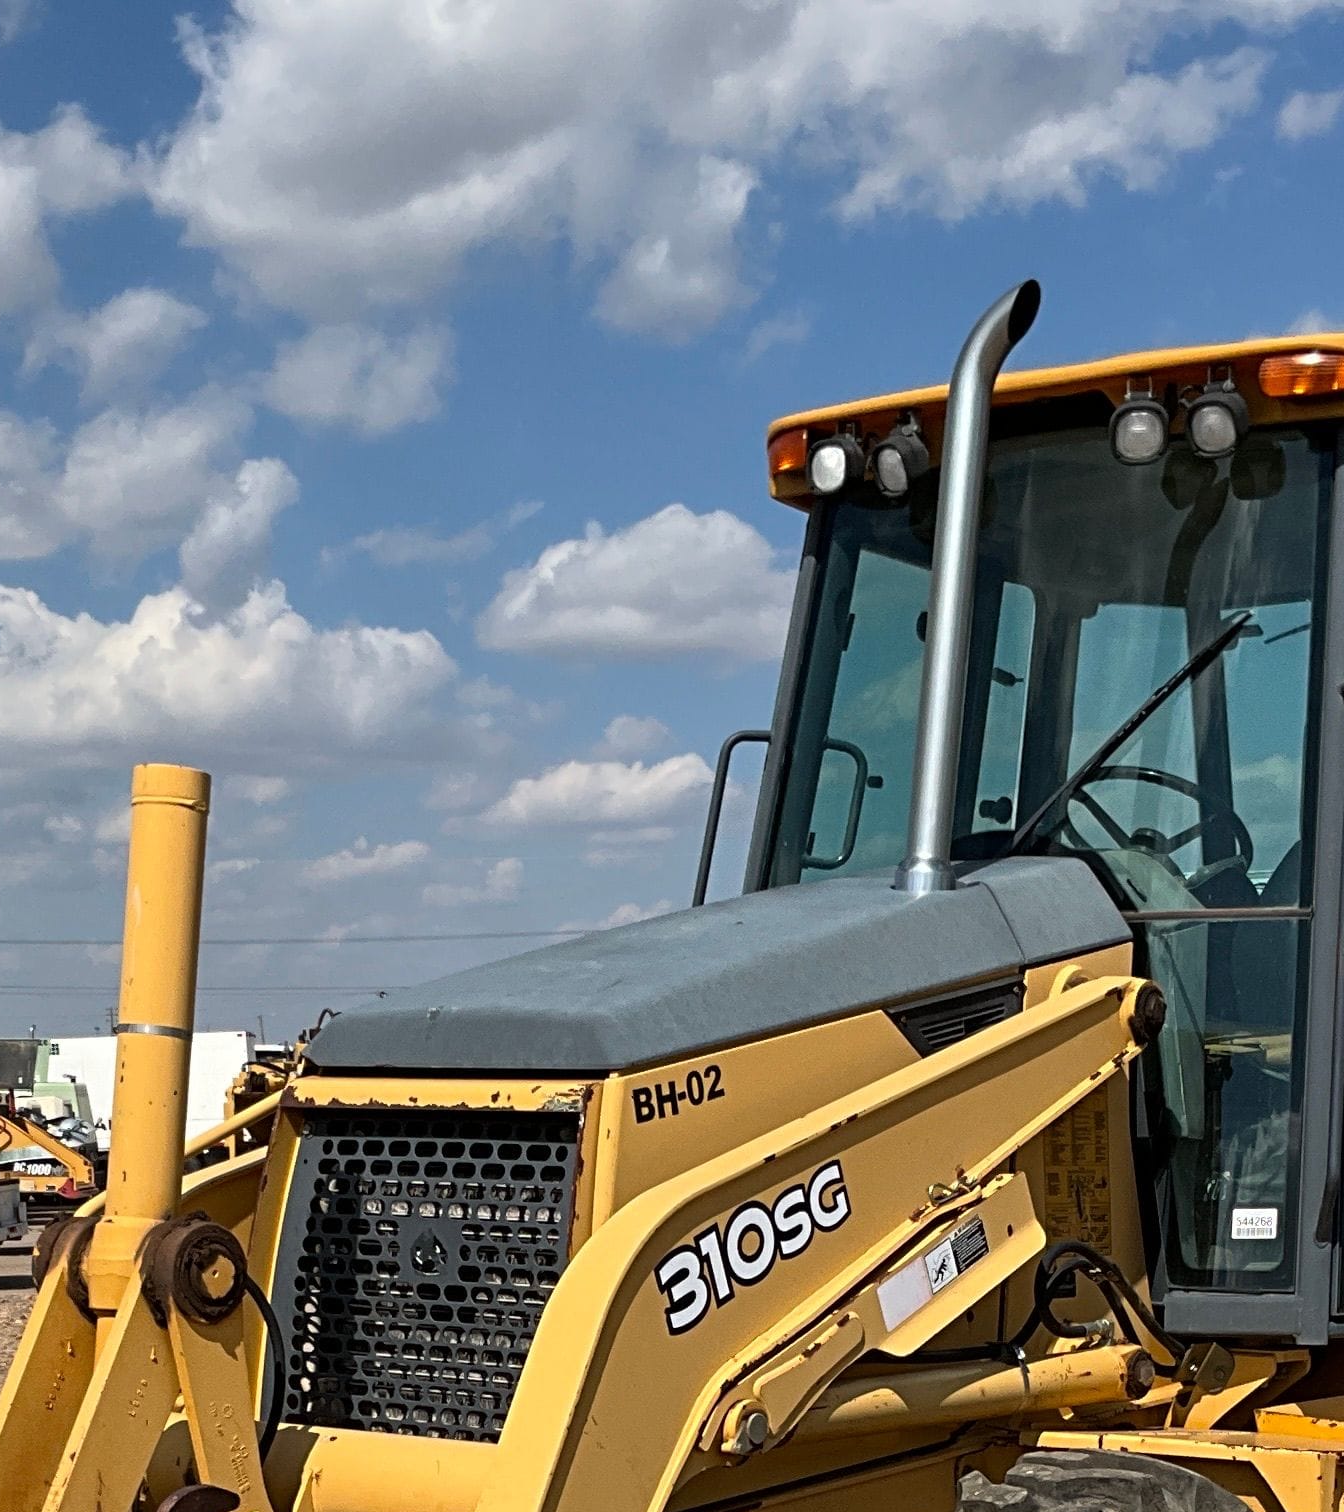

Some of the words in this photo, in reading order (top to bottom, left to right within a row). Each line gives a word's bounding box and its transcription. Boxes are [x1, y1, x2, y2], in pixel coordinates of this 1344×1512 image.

[632, 1064, 725, 1124] BH-02
[26, 1163, 52, 1176] 1000
[655, 1159, 852, 1336] 310SG
